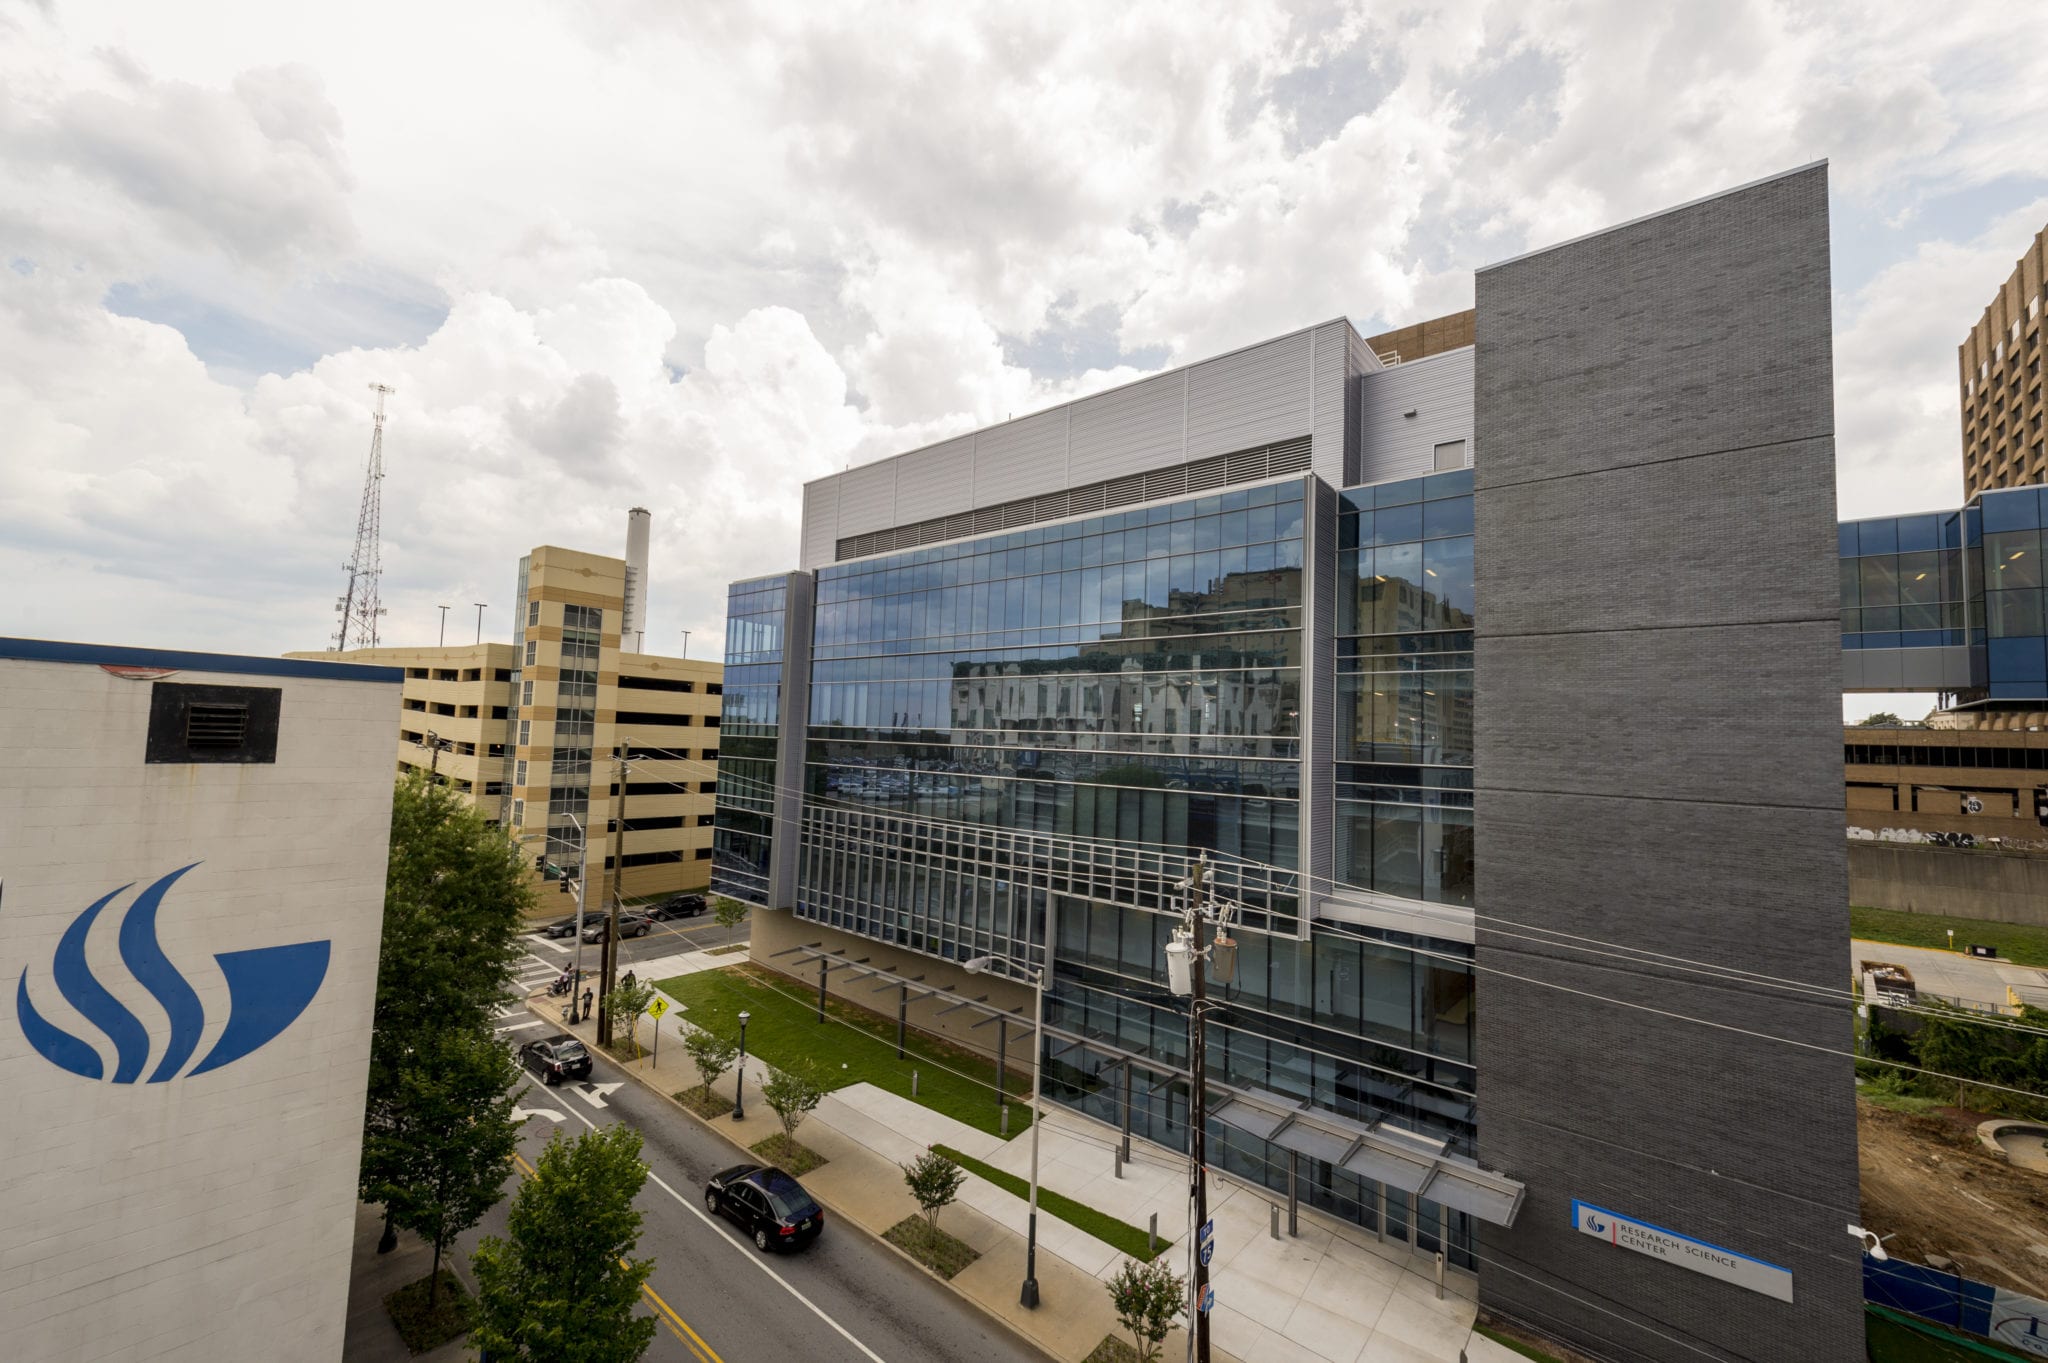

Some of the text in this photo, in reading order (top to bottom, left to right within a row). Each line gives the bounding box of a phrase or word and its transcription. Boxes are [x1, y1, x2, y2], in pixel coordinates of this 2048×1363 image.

[1620, 1224, 1737, 1269] RESEARCH SCIENCE
[1621, 1234, 1667, 1256] CENTER
